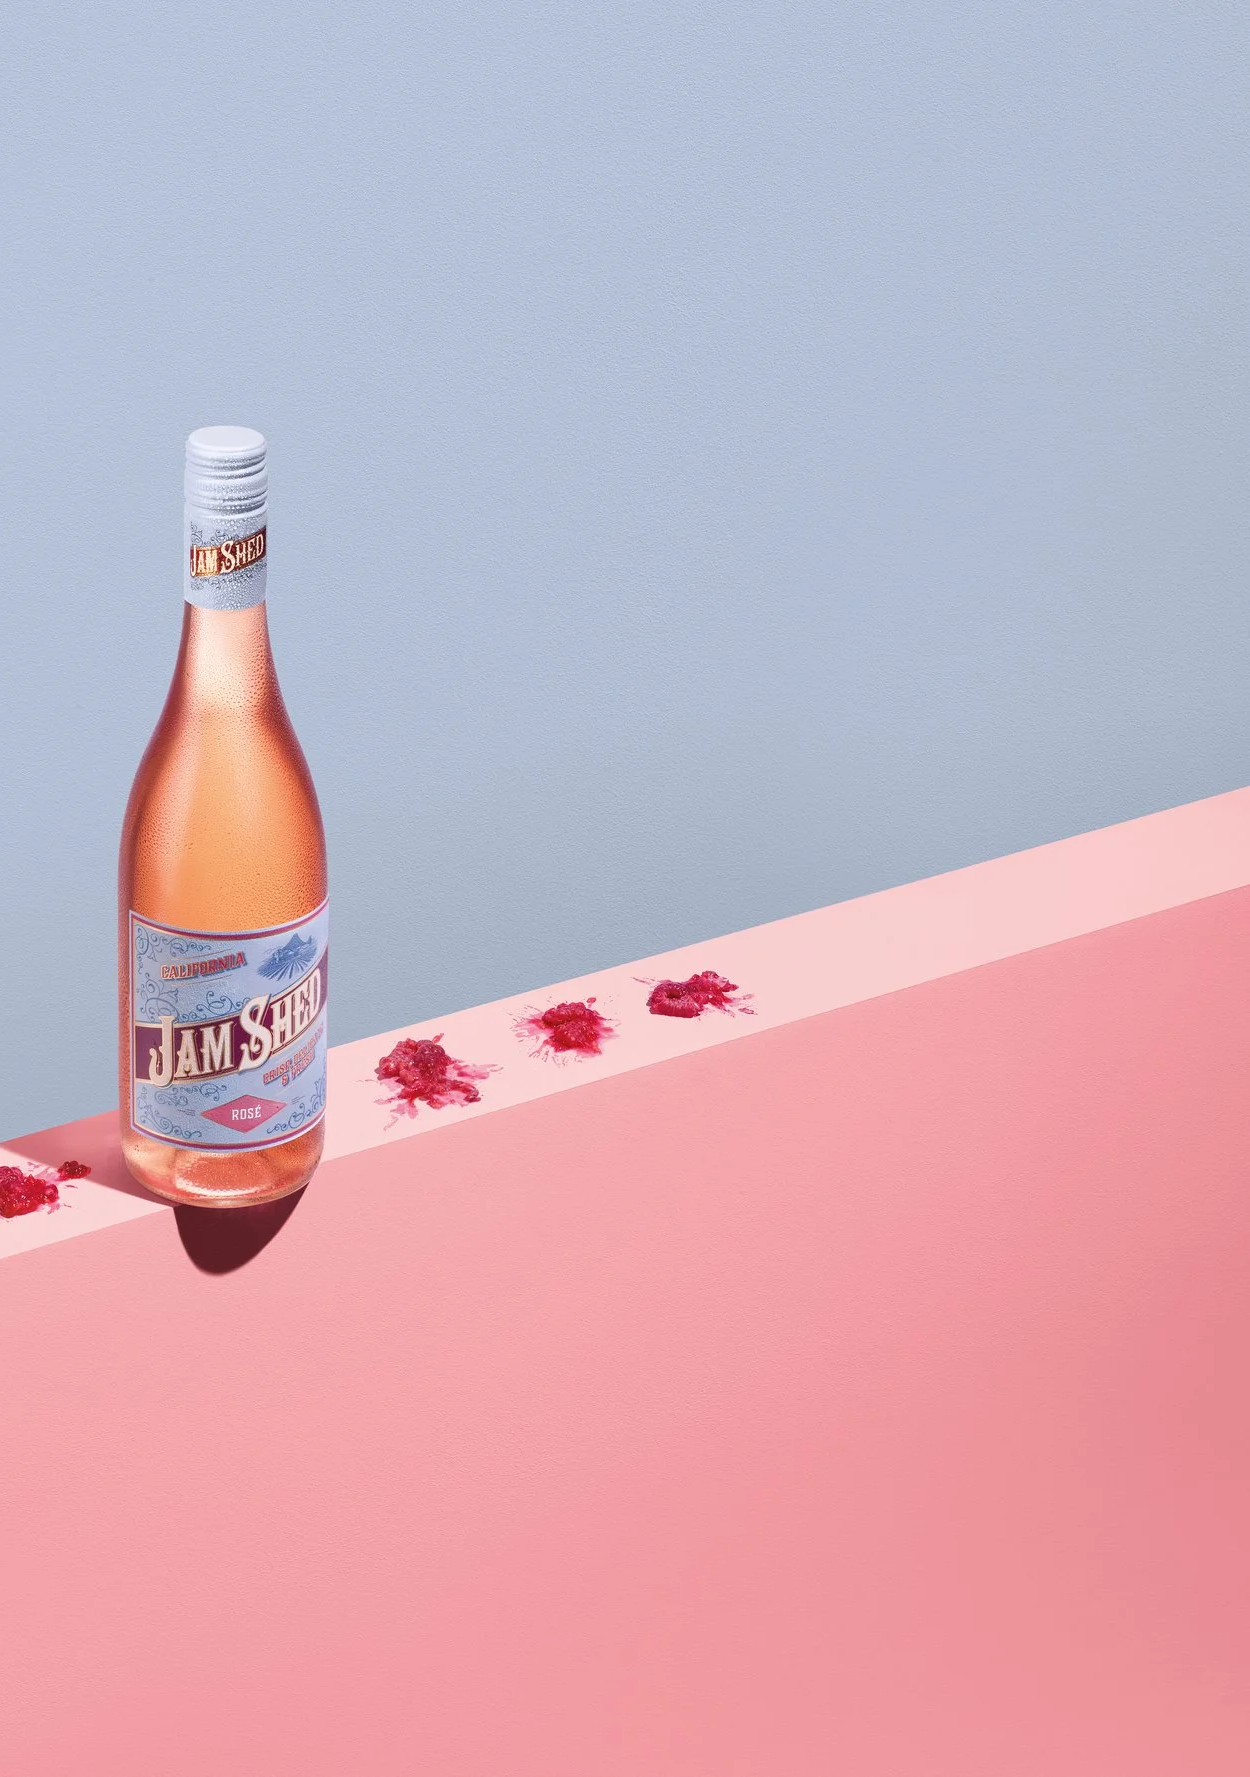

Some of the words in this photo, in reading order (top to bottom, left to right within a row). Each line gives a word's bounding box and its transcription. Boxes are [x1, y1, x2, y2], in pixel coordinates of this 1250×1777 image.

[191, 545, 217, 576] JAM
[220, 533, 264, 573] SHED
[161, 952, 246, 980] CALIFORNIA
[150, 1015, 234, 1087] JAM
[239, 970, 321, 1070] SHED
[231, 1104, 262, 1121] ROSÉ
